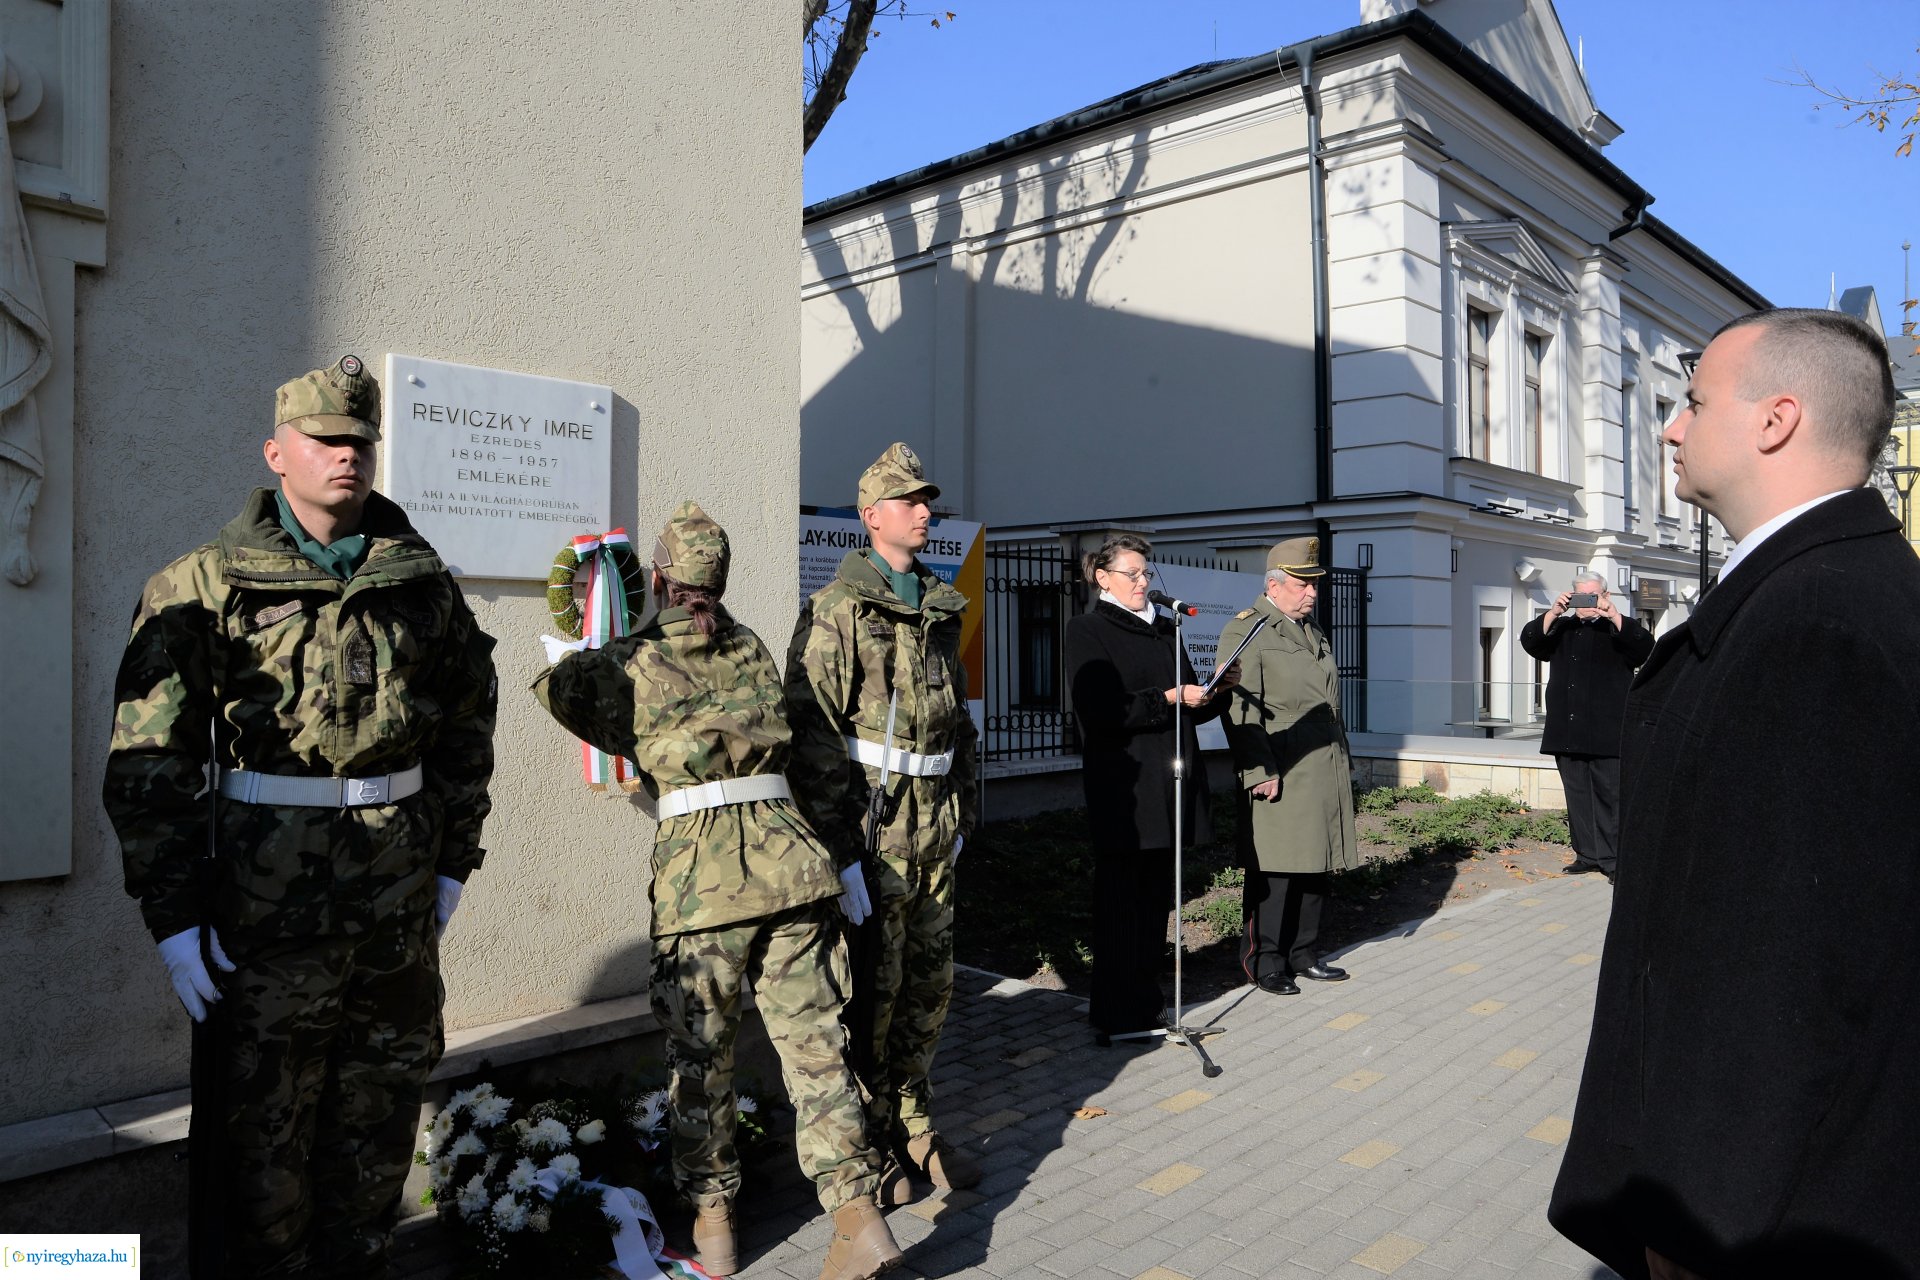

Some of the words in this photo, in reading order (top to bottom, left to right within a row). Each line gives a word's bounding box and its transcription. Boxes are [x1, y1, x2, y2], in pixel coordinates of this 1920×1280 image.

[413, 402, 531, 433] REVICZKY
[544, 419, 593, 440] IMRE
[471, 434, 542, 450] EZREDES
[451, 448, 496, 462] 1896
[519, 455, 559, 468] 1957
[458, 468, 552, 487] EMLÉKÉRE
[422, 490, 443, 499] AKI
[448, 492, 455, 500] A
[398, 499, 444, 513] PÉLDÁT
[448, 505, 514, 518] MUTATOTT
[916, 537, 962, 556] ZTÉSE
